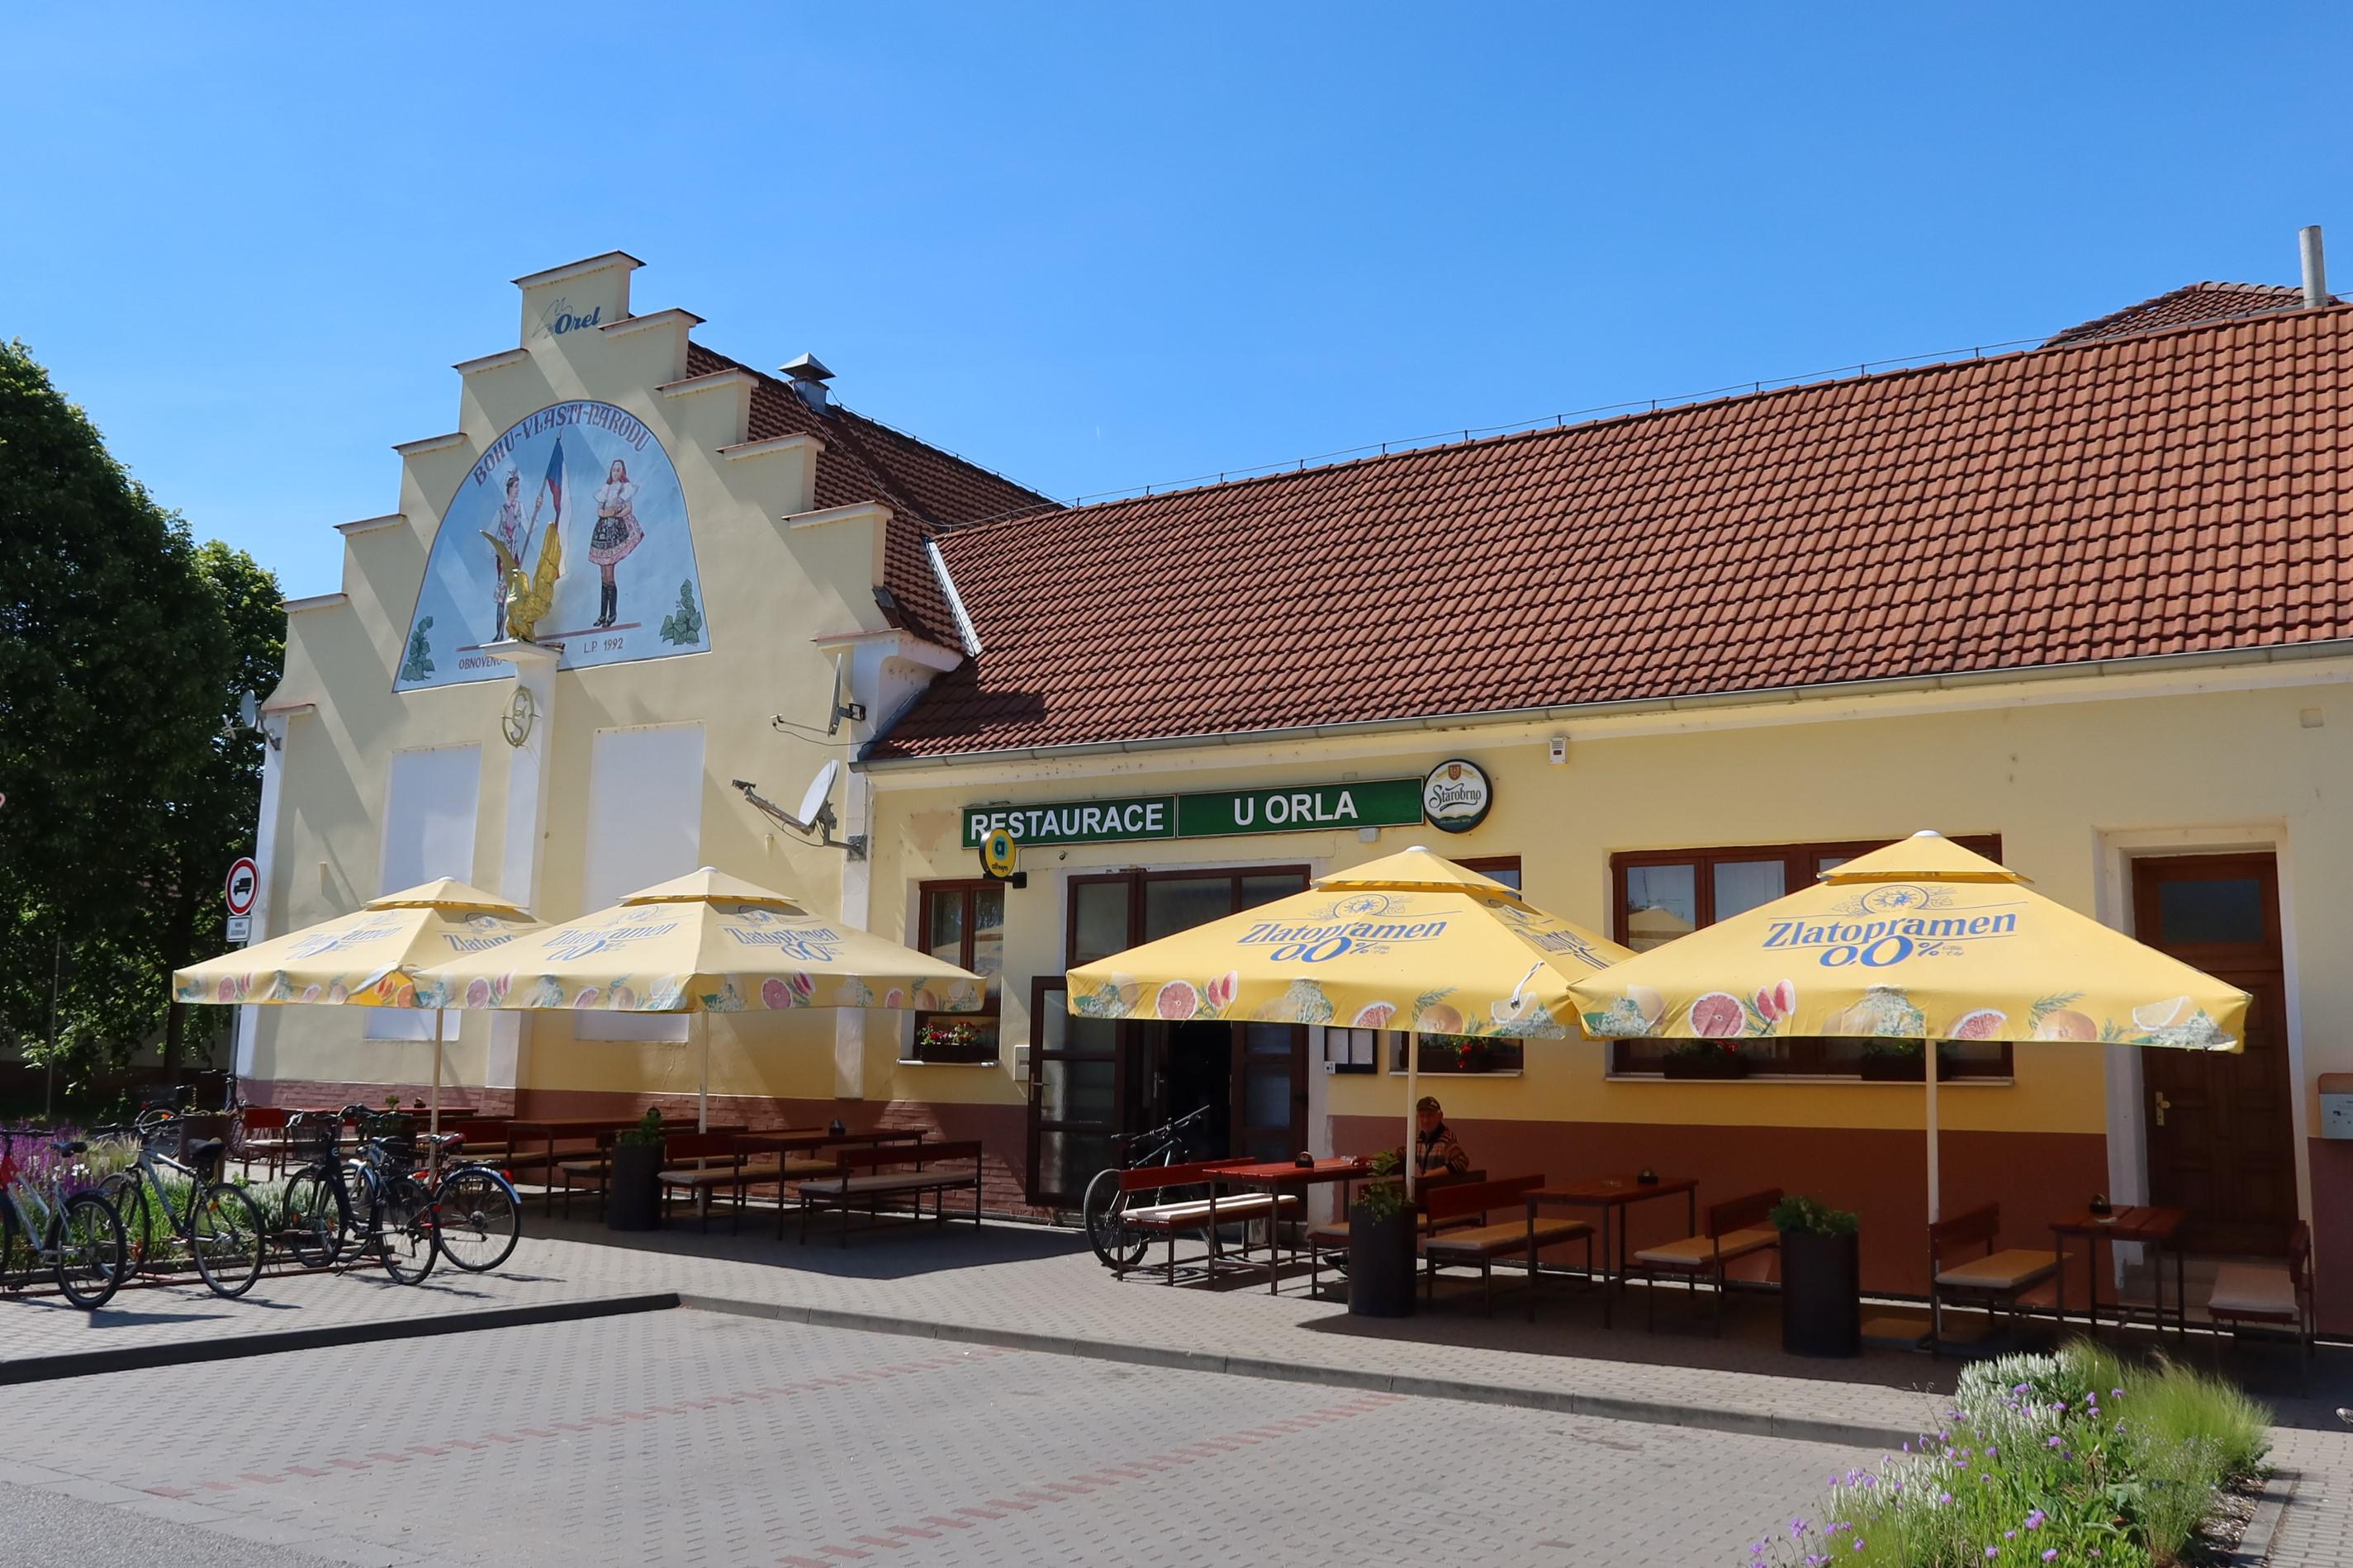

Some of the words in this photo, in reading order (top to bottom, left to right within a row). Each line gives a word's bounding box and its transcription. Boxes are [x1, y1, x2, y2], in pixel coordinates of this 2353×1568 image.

[555, 306, 600, 334] Orel
[603, 637, 624, 651] 1992
[1234, 797, 1255, 826] U
[1265, 790, 1359, 824] ORLA
[1429, 783, 1482, 810] Starobrno
[1236, 921, 1448, 944] Zlatopramen
[1762, 912, 2017, 948] Zlatopramen
